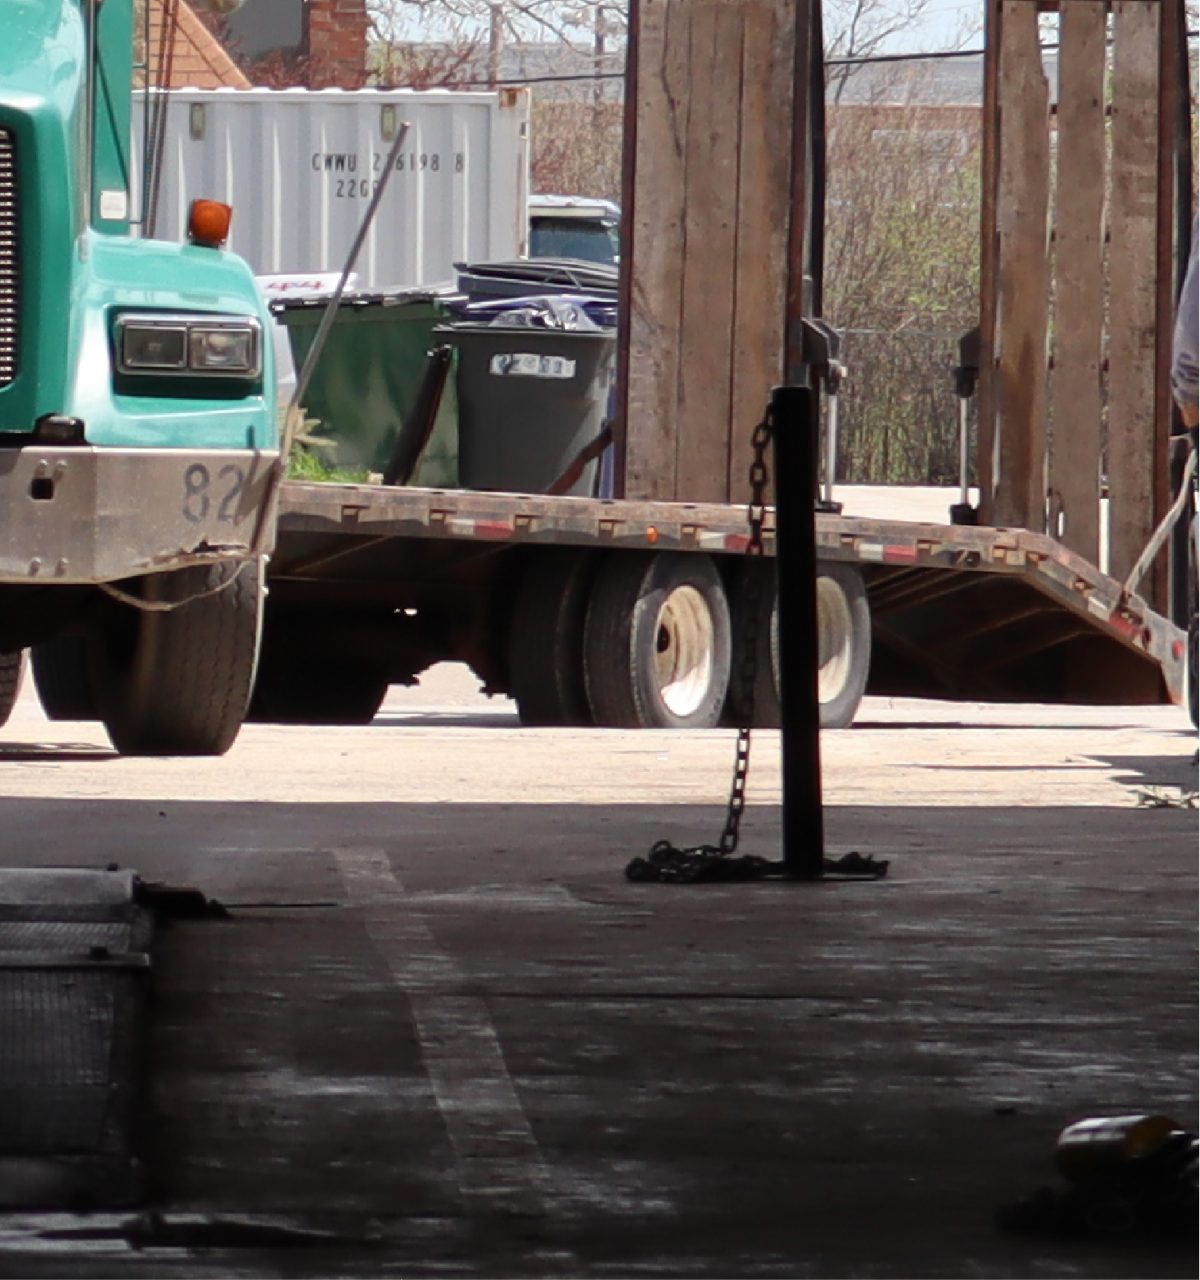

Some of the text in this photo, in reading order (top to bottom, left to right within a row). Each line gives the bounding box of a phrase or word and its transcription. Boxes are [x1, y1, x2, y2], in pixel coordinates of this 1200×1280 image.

[312, 154, 356, 172] CWWU
[455, 154, 464, 172] 8
[183, 463, 245, 523] 82
